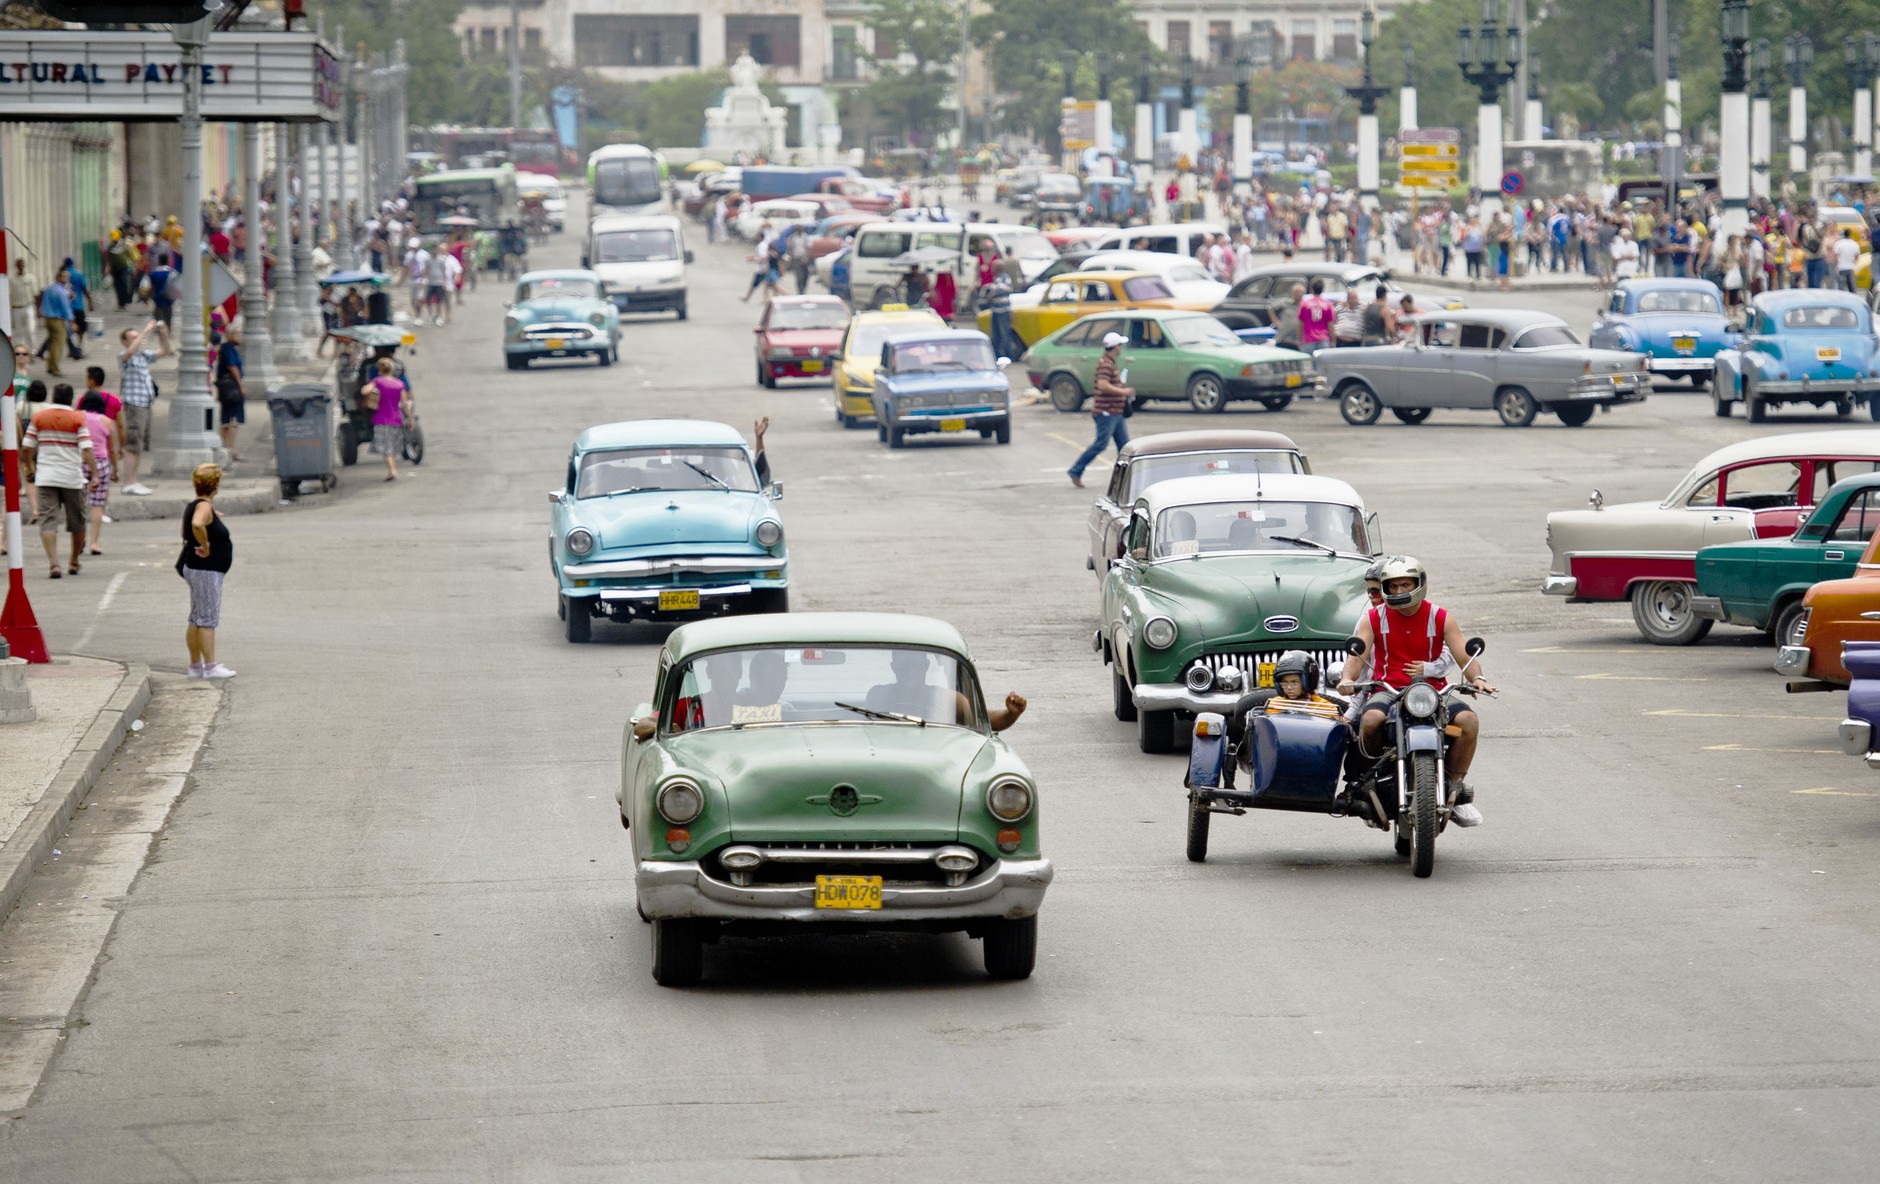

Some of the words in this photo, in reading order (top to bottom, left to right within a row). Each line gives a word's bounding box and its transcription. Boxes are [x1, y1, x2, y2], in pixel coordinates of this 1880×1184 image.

[1259, 669, 1275, 681] HH
[736, 708, 777, 719] TAXI
[817, 884, 880, 901] HDW078
